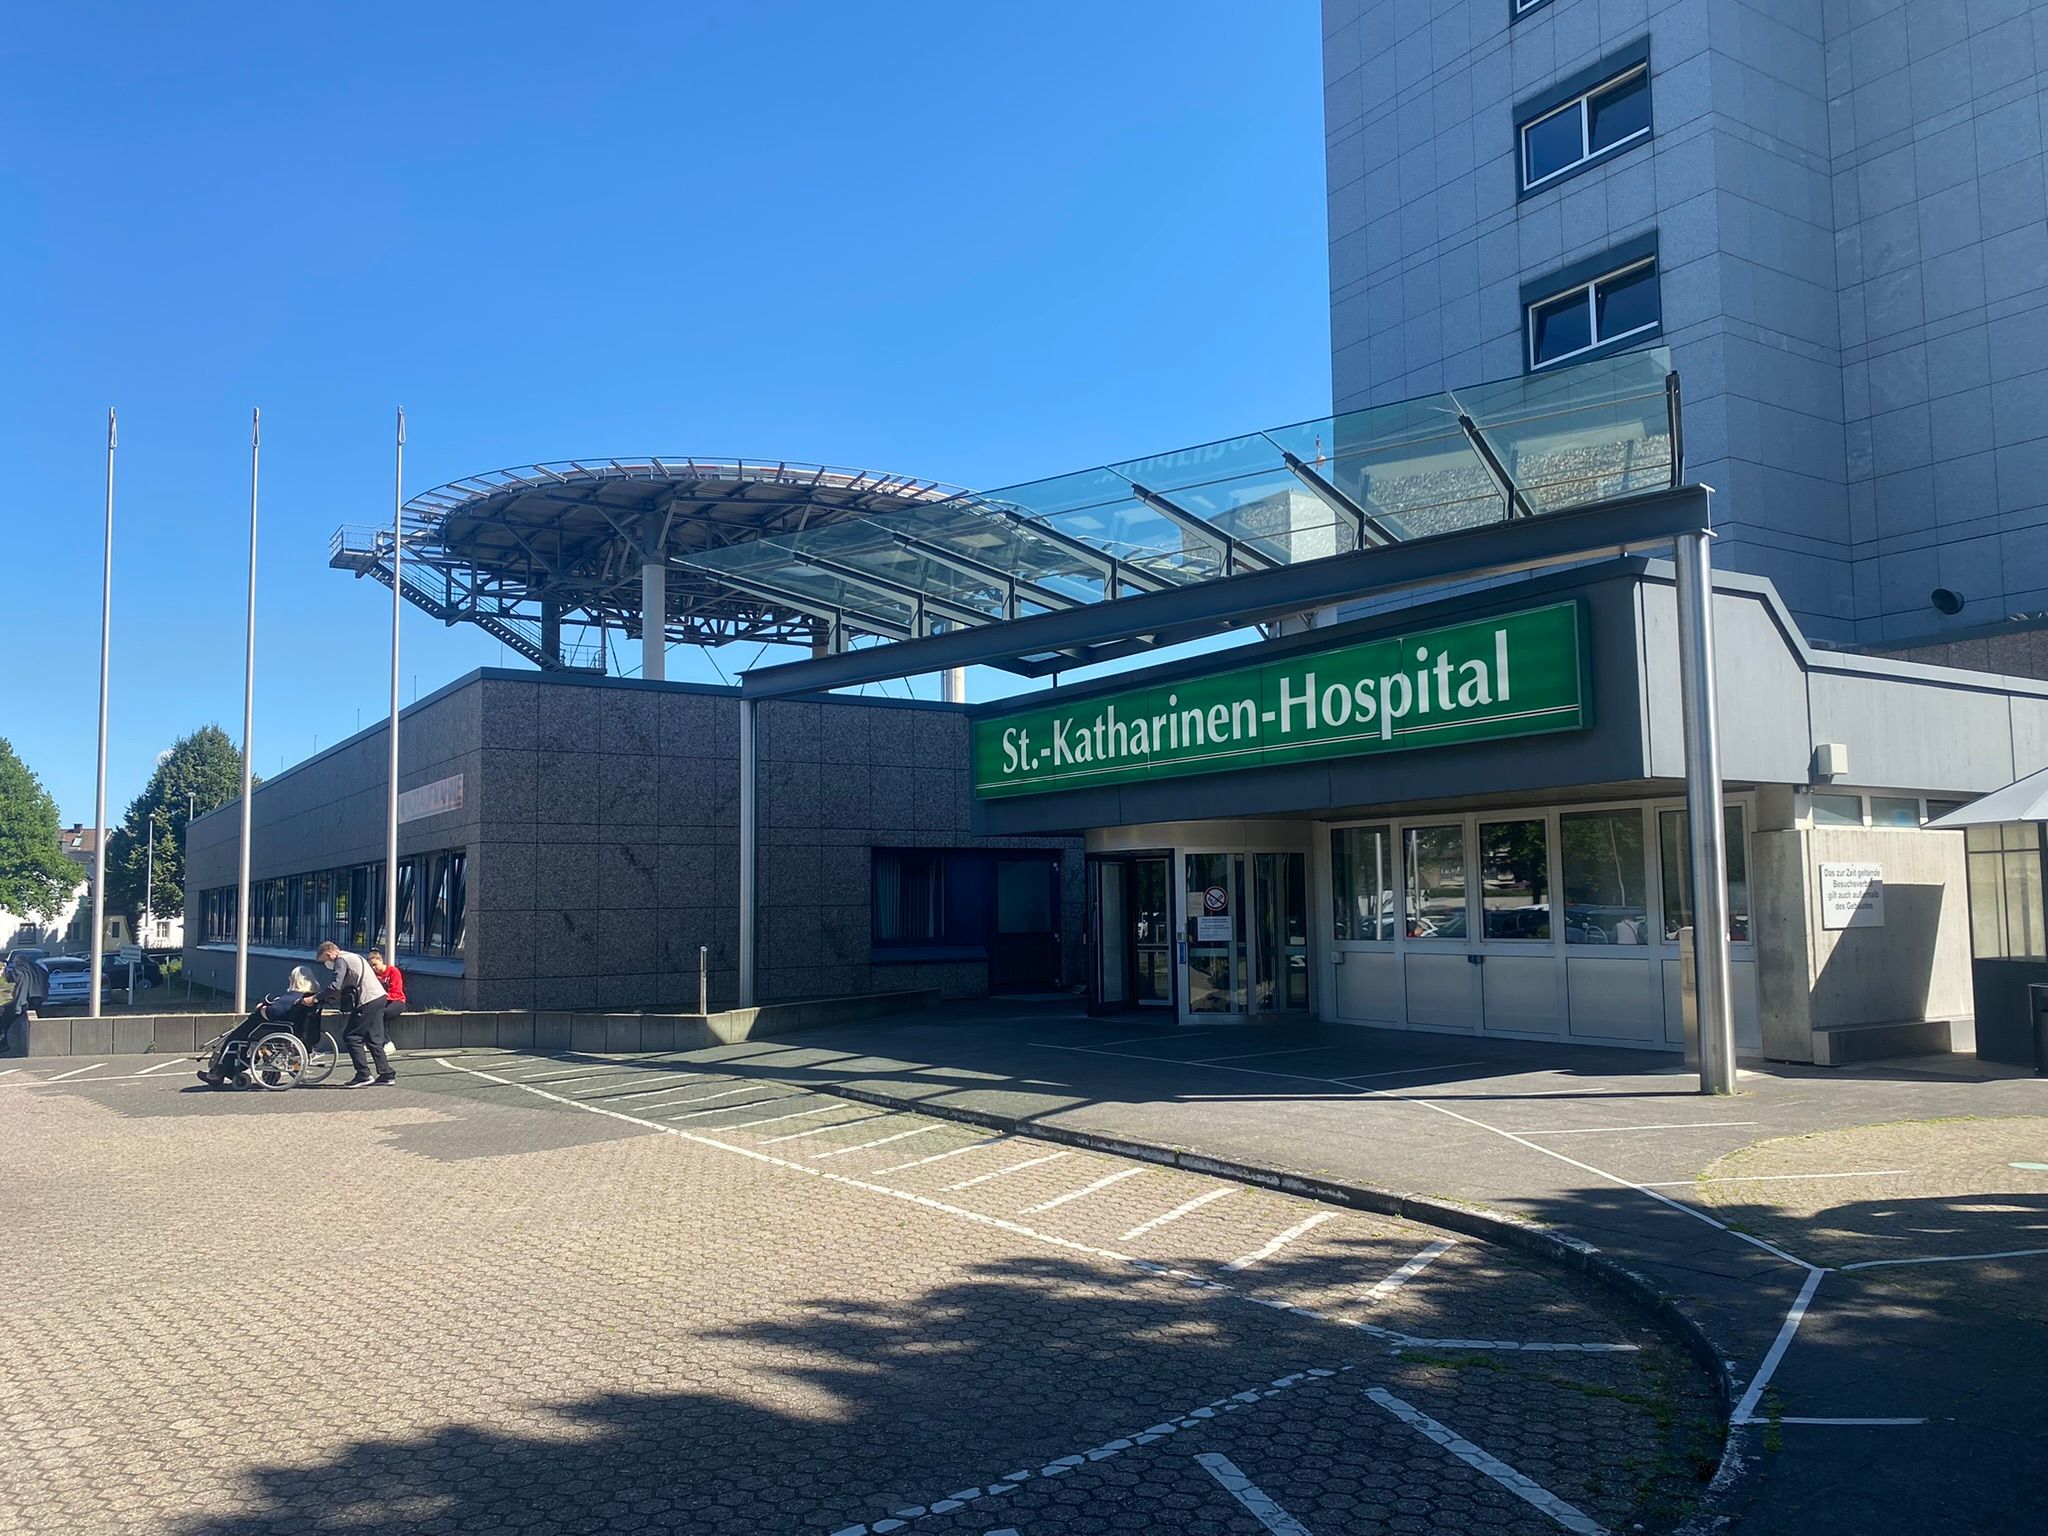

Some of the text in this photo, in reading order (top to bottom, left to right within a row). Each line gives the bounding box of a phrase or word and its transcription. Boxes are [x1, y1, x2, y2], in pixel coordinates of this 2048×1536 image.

[1001, 628, 1511, 775] St.-Katharinen-Hospital
[1824, 868, 1835, 877] Das
[1846, 868, 1857, 877] Zeit
[1857, 868, 1881, 879] geltende
[1828, 890, 1837, 901] gilt
[1838, 890, 1852, 899] auch
[1835, 901, 1846, 910] des
